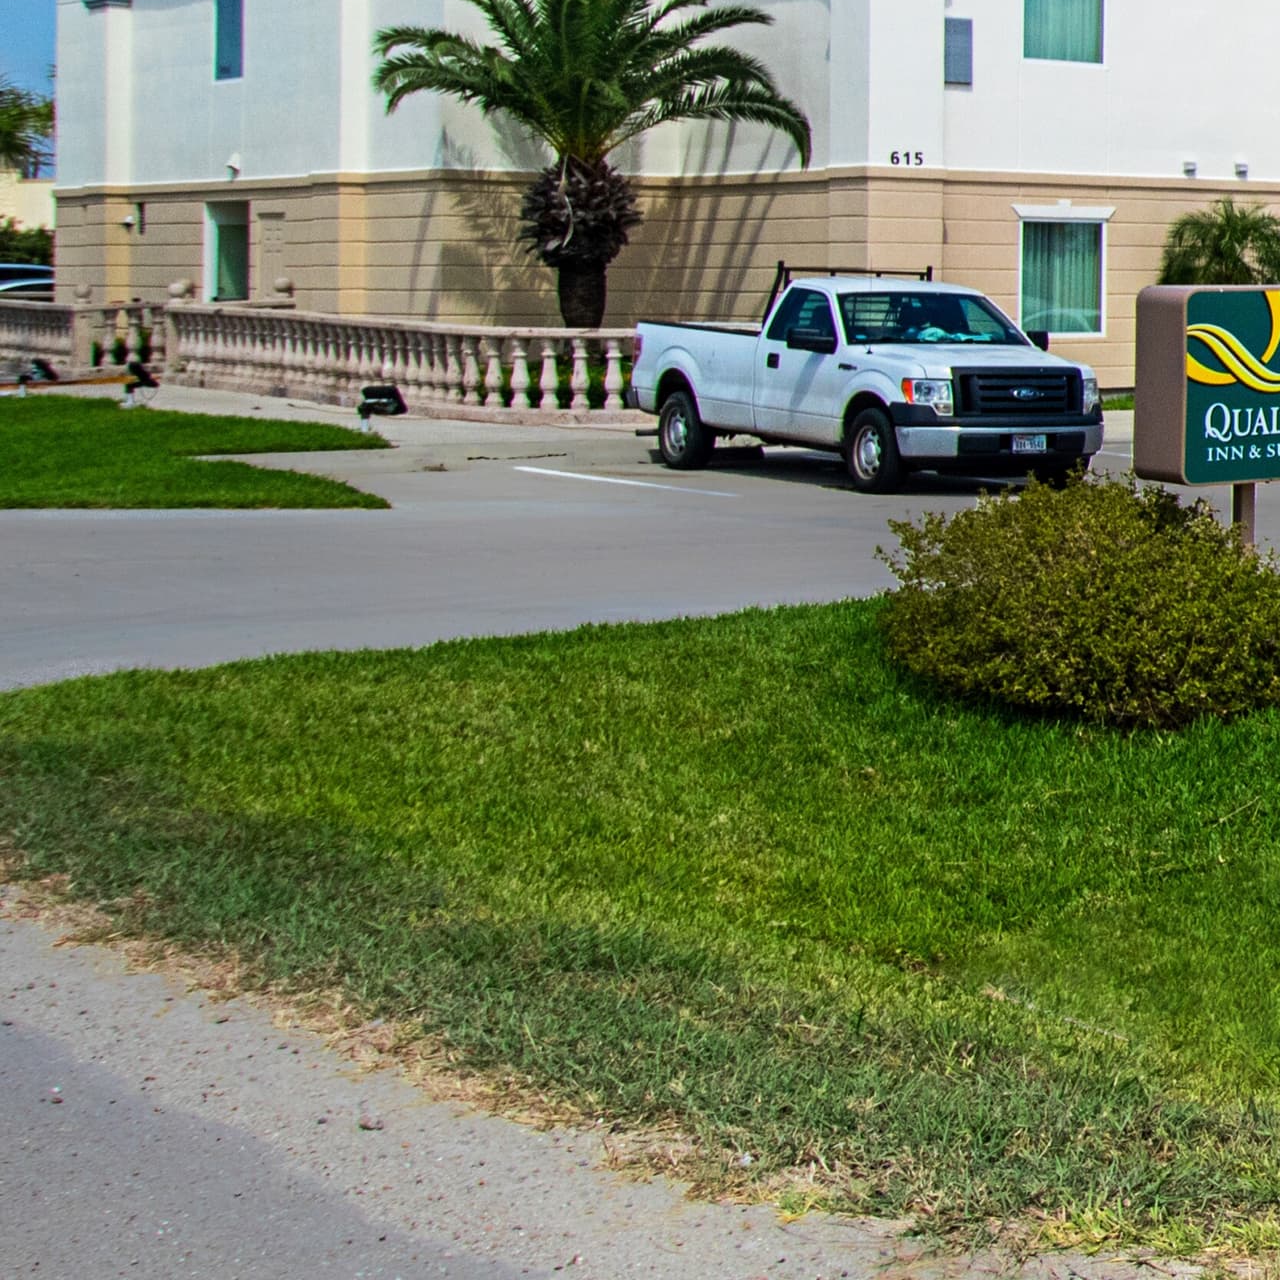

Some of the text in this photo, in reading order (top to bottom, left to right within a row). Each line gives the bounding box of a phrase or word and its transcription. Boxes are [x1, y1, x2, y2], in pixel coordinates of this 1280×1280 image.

[890, 150, 924, 166] 615
[1207, 445, 1244, 462] INN
[1249, 444, 1261, 460] &
